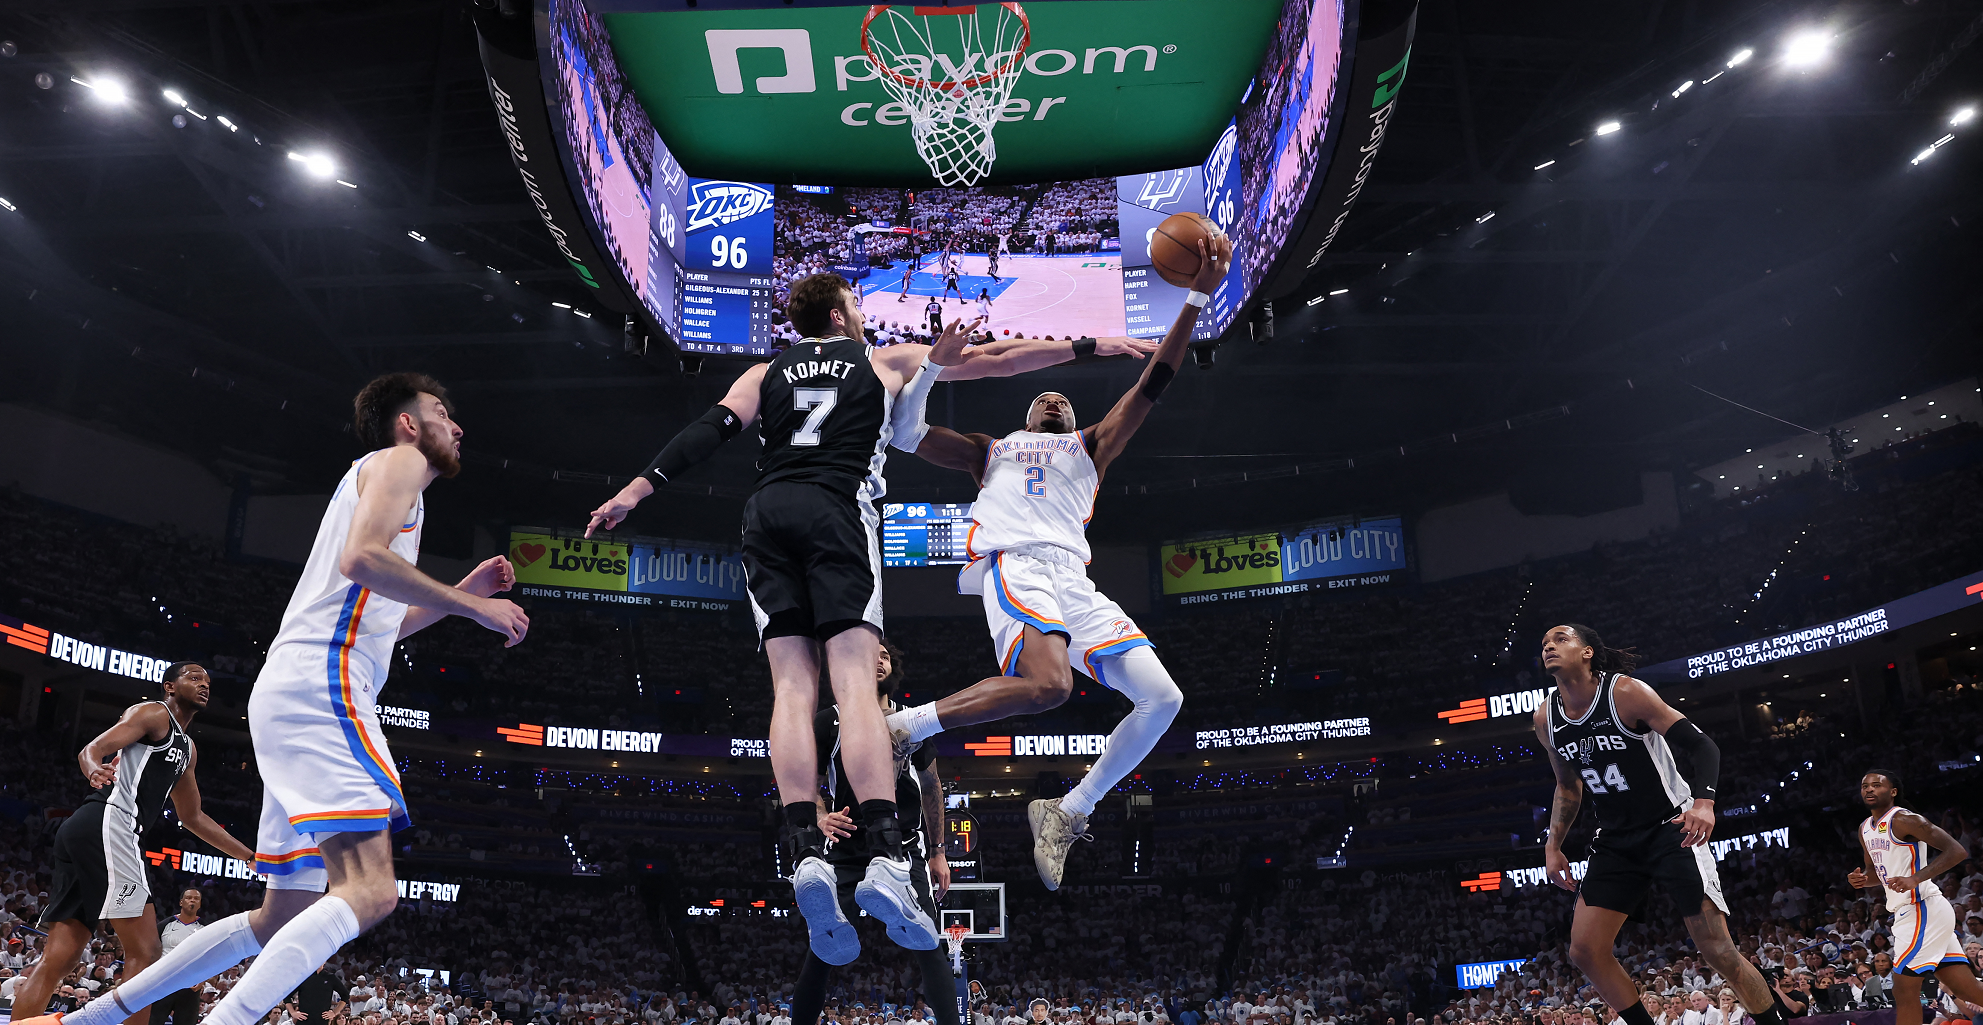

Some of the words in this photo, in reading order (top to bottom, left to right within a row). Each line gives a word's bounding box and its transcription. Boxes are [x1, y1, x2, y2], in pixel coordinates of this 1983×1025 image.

[490, 77, 528, 162] center
[1343, 100, 1394, 206] paycom
[519, 167, 582, 262] paycom
[1218, 189, 1234, 235] 96
[660, 203, 675, 248] 88
[711, 235, 748, 269] 96
[687, 273, 708, 281] PLAYER
[1125, 269, 1147, 278] PLAYER
[685, 285, 749, 296] GILGEOUS-ALEXANDER
[1125, 281, 1148, 289] HARPER
[684, 296, 713, 304] WILLIAMS
[1126, 304, 1149, 312] KORNET
[684, 307, 716, 316] HOLMGREN
[1127, 315, 1151, 323] VASSELL
[683, 319, 710, 327] WALLACE
[1128, 326, 1166, 335] CHAMPAGNIE
[683, 330, 712, 339] WILLIAMS
[1198, 331, 1211, 339] 1:18
[783, 360, 855, 384] KORNET
[790, 387, 838, 446] 7
[992, 438, 1081, 458] OKLAHOMA
[1016, 451, 1054, 464] CITY
[1025, 464, 1046, 498] 2
[906, 505, 927, 517] 96
[941, 508, 961, 516] 1:18
[1286, 532, 1342, 575] LOUD
[1350, 529, 1398, 562] CITY
[634, 553, 687, 586] LOUD
[696, 555, 740, 593] CITY
[522, 587, 561, 598] BRING
[565, 591, 589, 601] THE
[594, 593, 652, 605] THUNDER
[670, 600, 698, 609] EXIT
[701, 602, 729, 611] NOW
[1180, 594, 1218, 605] BRING
[1221, 590, 1246, 601] THE
[1249, 583, 1308, 597] THUNDER
[1328, 578, 1356, 589] EXIT
[1361, 575, 1390, 585] NOW
[1687, 651, 1726, 668] PROUD
[1727, 647, 1743, 659] TO
[1745, 643, 1760, 654] BE
[1762, 640, 1771, 650] A
[1772, 625, 1835, 648] FOUNDING
[1837, 608, 1886, 632] PARTNER
[50, 633, 107, 671] DEVON
[1688, 667, 1704, 679] OF
[1706, 661, 1729, 675] THE
[1731, 647, 1800, 668] OKLAHOMA
[1803, 637, 1832, 652] CITY
[1835, 620, 1888, 644] THUNDER
[384, 706, 430, 720] PARTNER
[1489, 688, 1545, 718] DEVON
[380, 715, 430, 730] THUNDER
[1196, 729, 1229, 740] PROUD
[1231, 729, 1244, 737] TO
[1247, 727, 1259, 736] BE
[1261, 726, 1269, 735] A
[1270, 722, 1322, 734] FOUNDING
[1324, 717, 1369, 729] PARTNER
[546, 726, 598, 750] DEVON
[602, 730, 662, 753] ENERGY
[731, 738, 764, 749] PROUD
[1015, 736, 1065, 755] DEVON
[1068, 735, 1111, 755] ENER
[1196, 740, 1210, 749] OF
[1212, 739, 1232, 748] THE
[1234, 733, 1293, 746] OKLAHOMA
[1295, 731, 1319, 740] CITY
[1321, 726, 1370, 739] THUNDER
[730, 748, 744, 757] OF
[746, 749, 765, 757] THE
[1558, 735, 1627, 765] SPURS
[1580, 763, 1630, 794] 24
[1264, 802, 1317, 813] CAINO
[951, 821, 971, 832] 1:18
[956, 832, 970, 852] 7
[181, 851, 223, 876] DEVON
